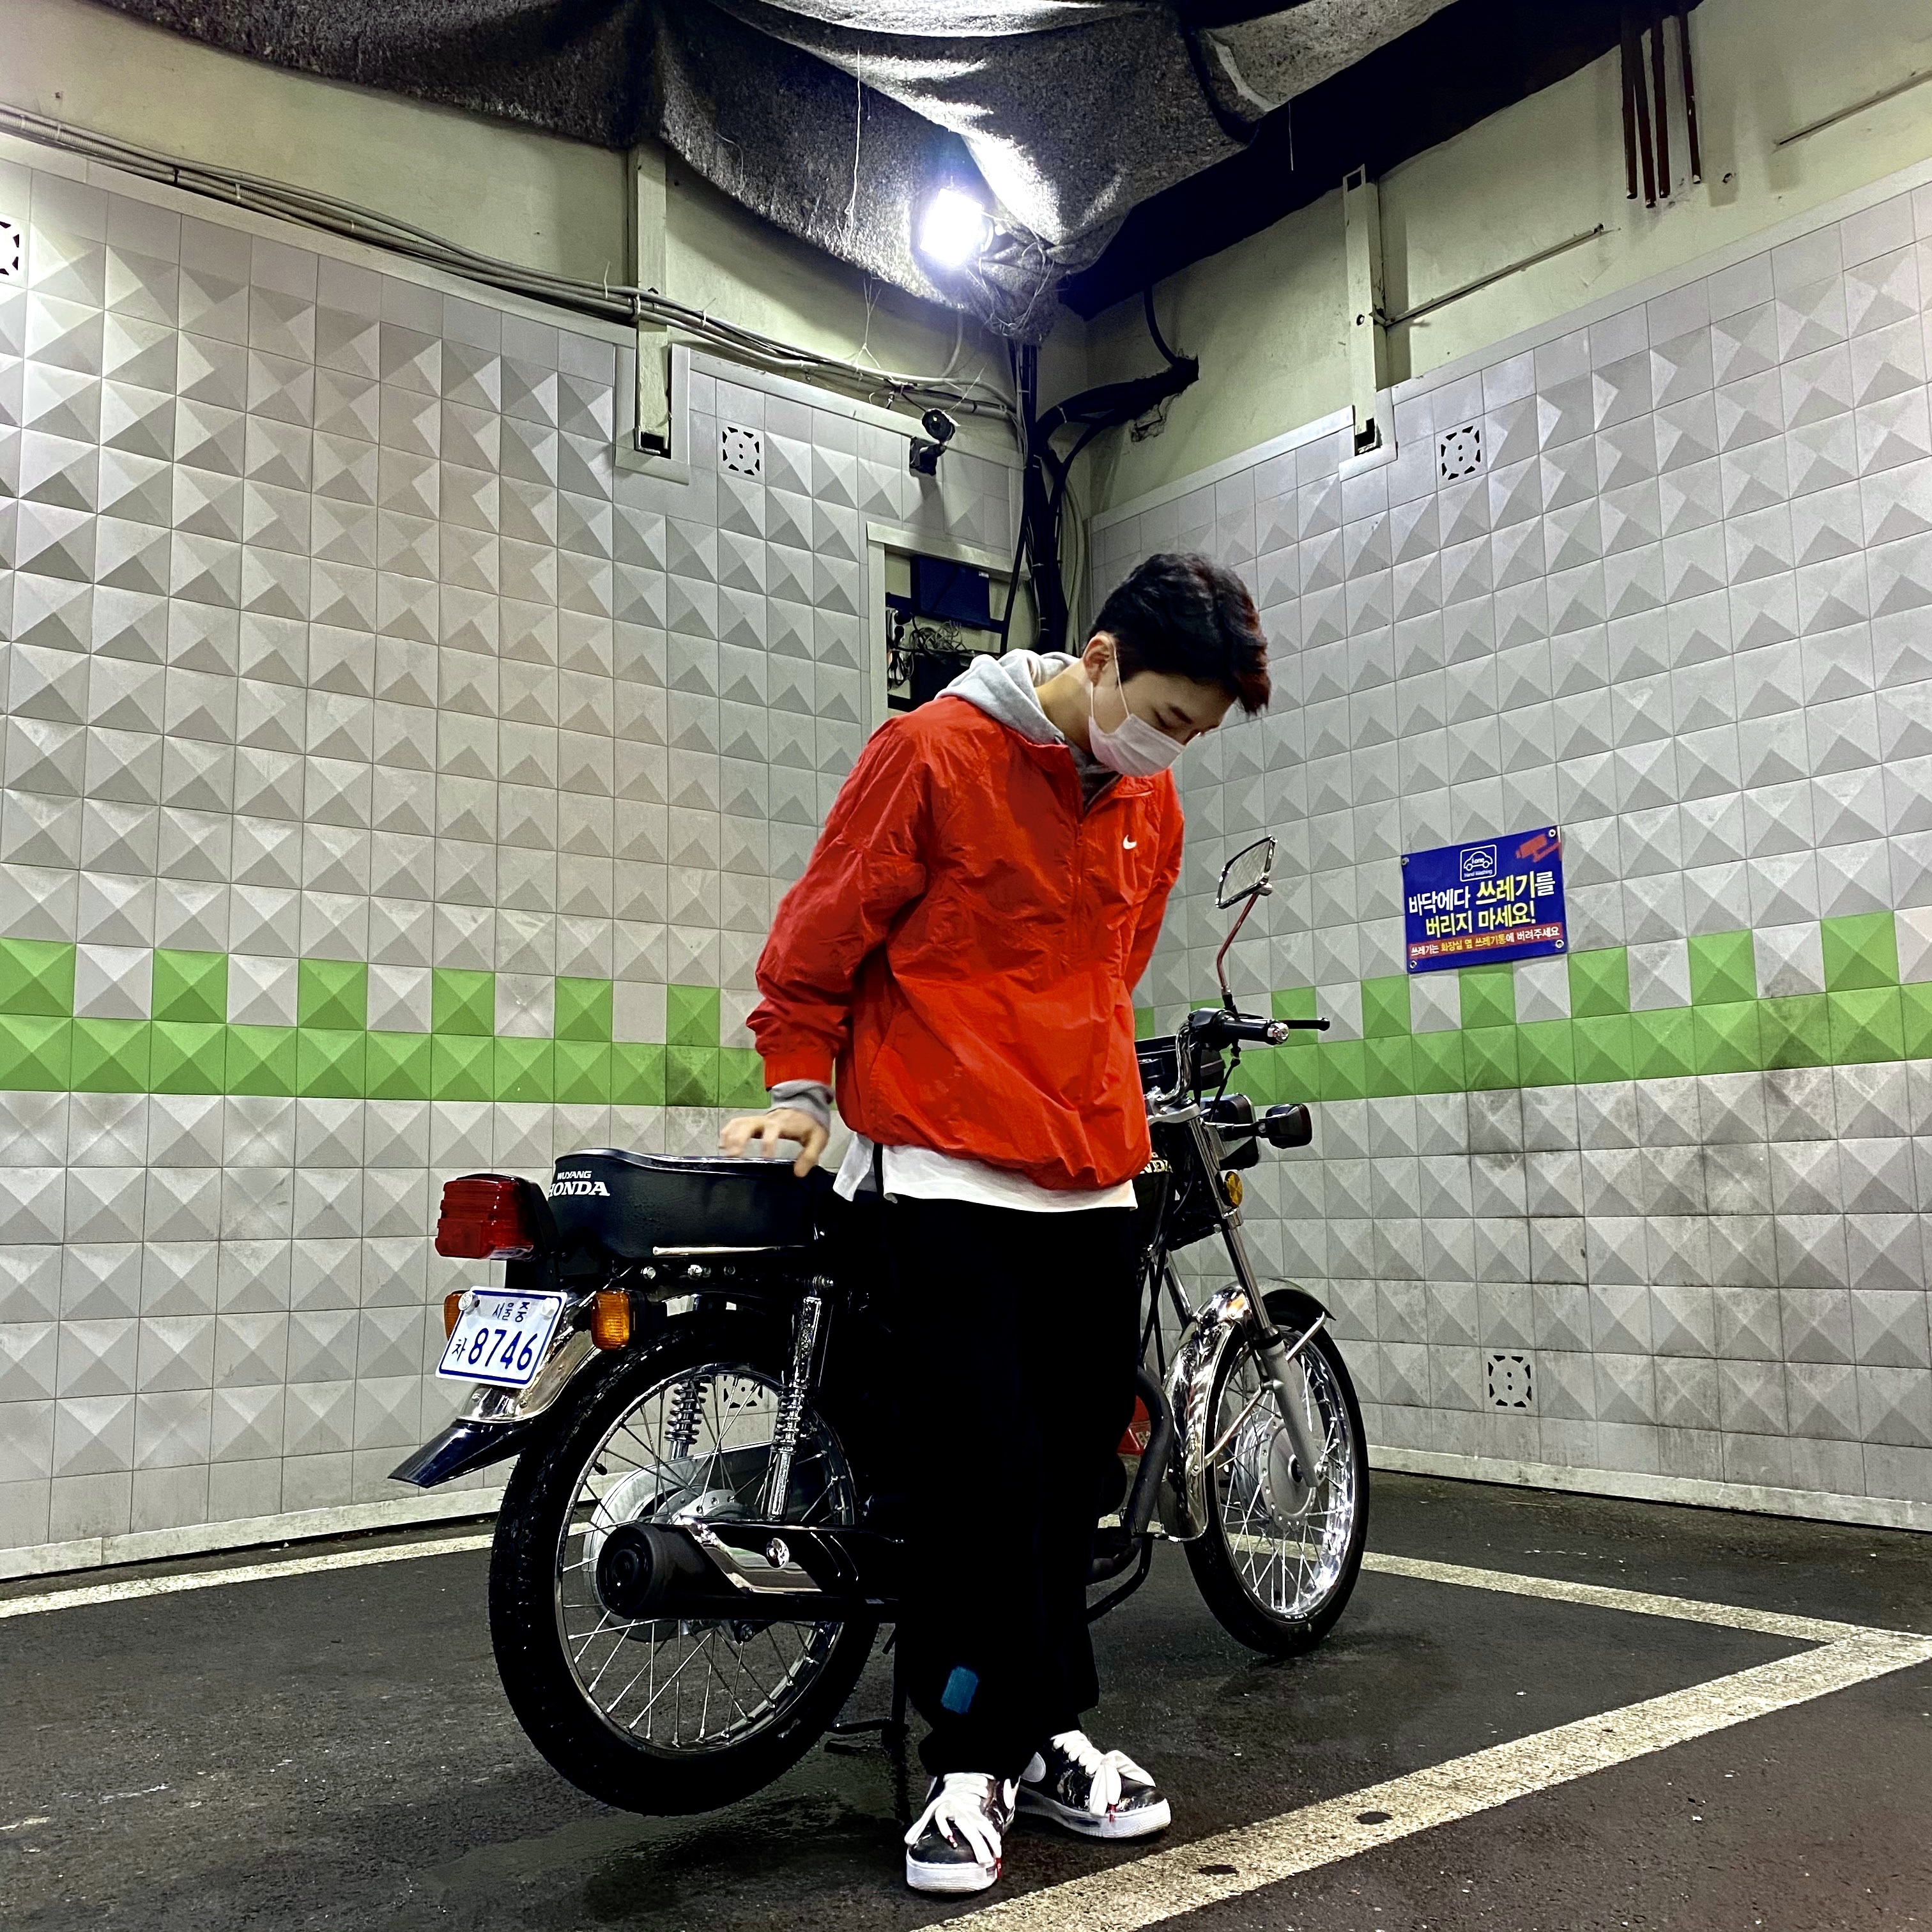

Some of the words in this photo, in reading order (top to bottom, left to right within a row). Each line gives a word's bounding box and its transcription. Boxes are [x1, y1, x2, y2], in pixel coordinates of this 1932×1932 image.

[1408, 885, 1471, 916] 바닥에다
[1476, 871, 1556, 905] 쓰레기를
[1425, 910, 1473, 938] 버리지
[1478, 900, 1536, 930] 마세요!
[1411, 944, 1439, 956] 쓰레기는
[1441, 939, 1463, 951] 화장실
[1475, 932, 1515, 946] 쓰레기통에
[1517, 926, 1560, 941] 버려주세요
[557, 1170, 592, 1180] WUYANG
[492, 1302, 514, 1321] 서울
[514, 1301, 530, 1322] 중
[468, 1328, 538, 1371] 8746
